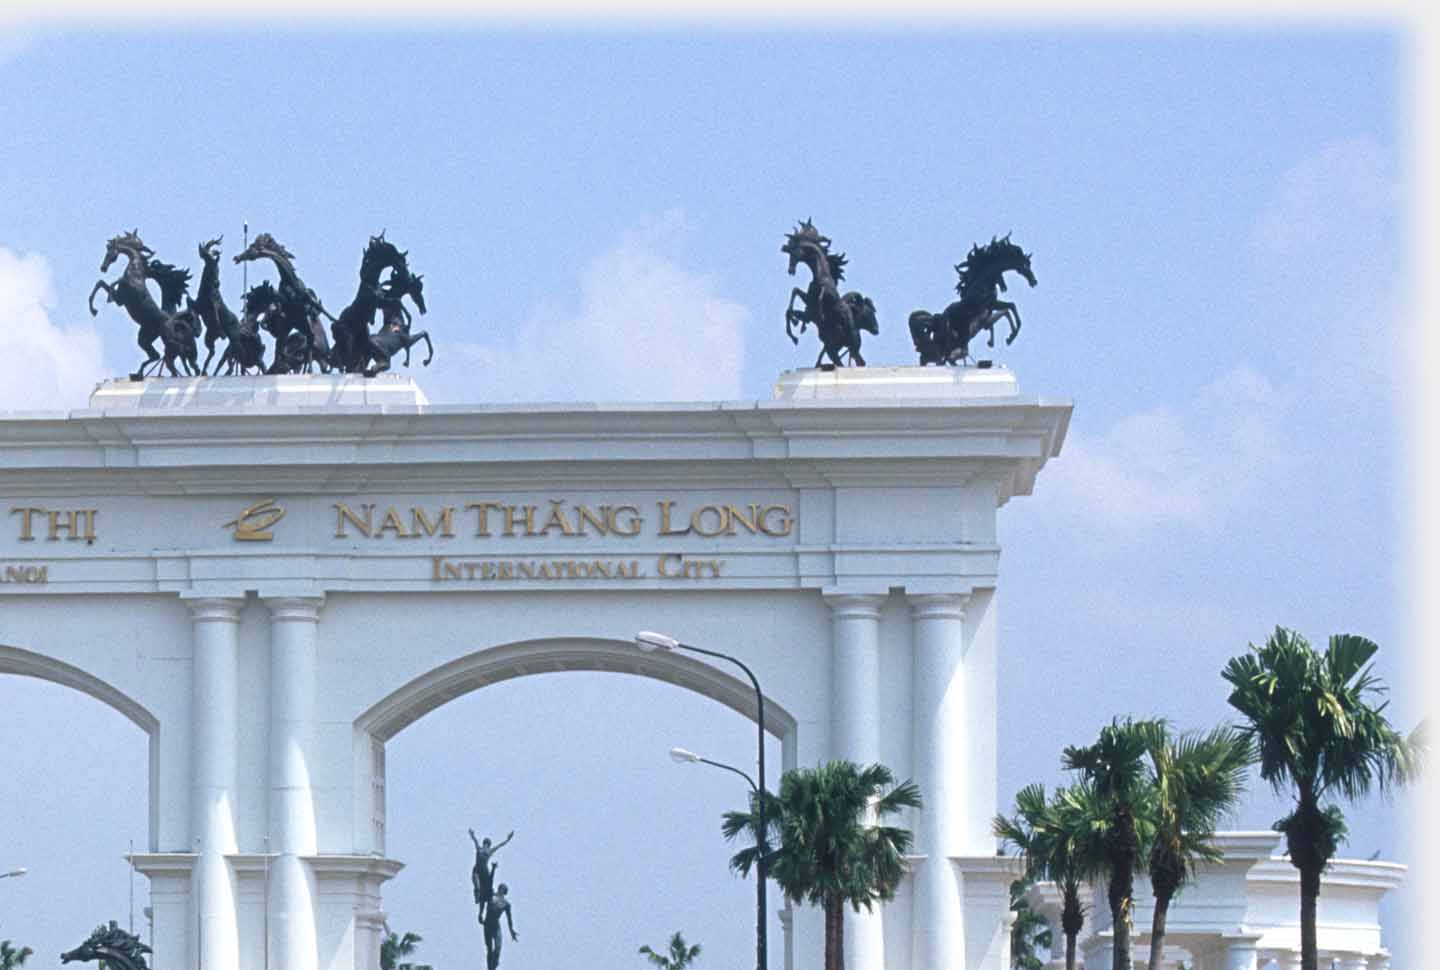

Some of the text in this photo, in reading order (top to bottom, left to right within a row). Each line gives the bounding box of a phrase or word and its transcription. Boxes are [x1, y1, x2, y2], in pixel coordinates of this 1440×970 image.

[10, 507, 97, 545] THỊ
[332, 501, 455, 538] NAM
[465, 499, 642, 537] THĂNG
[657, 500, 794, 537] LONG
[432, 555, 646, 581] INTERNATIONAL
[657, 553, 726, 579] CITY
